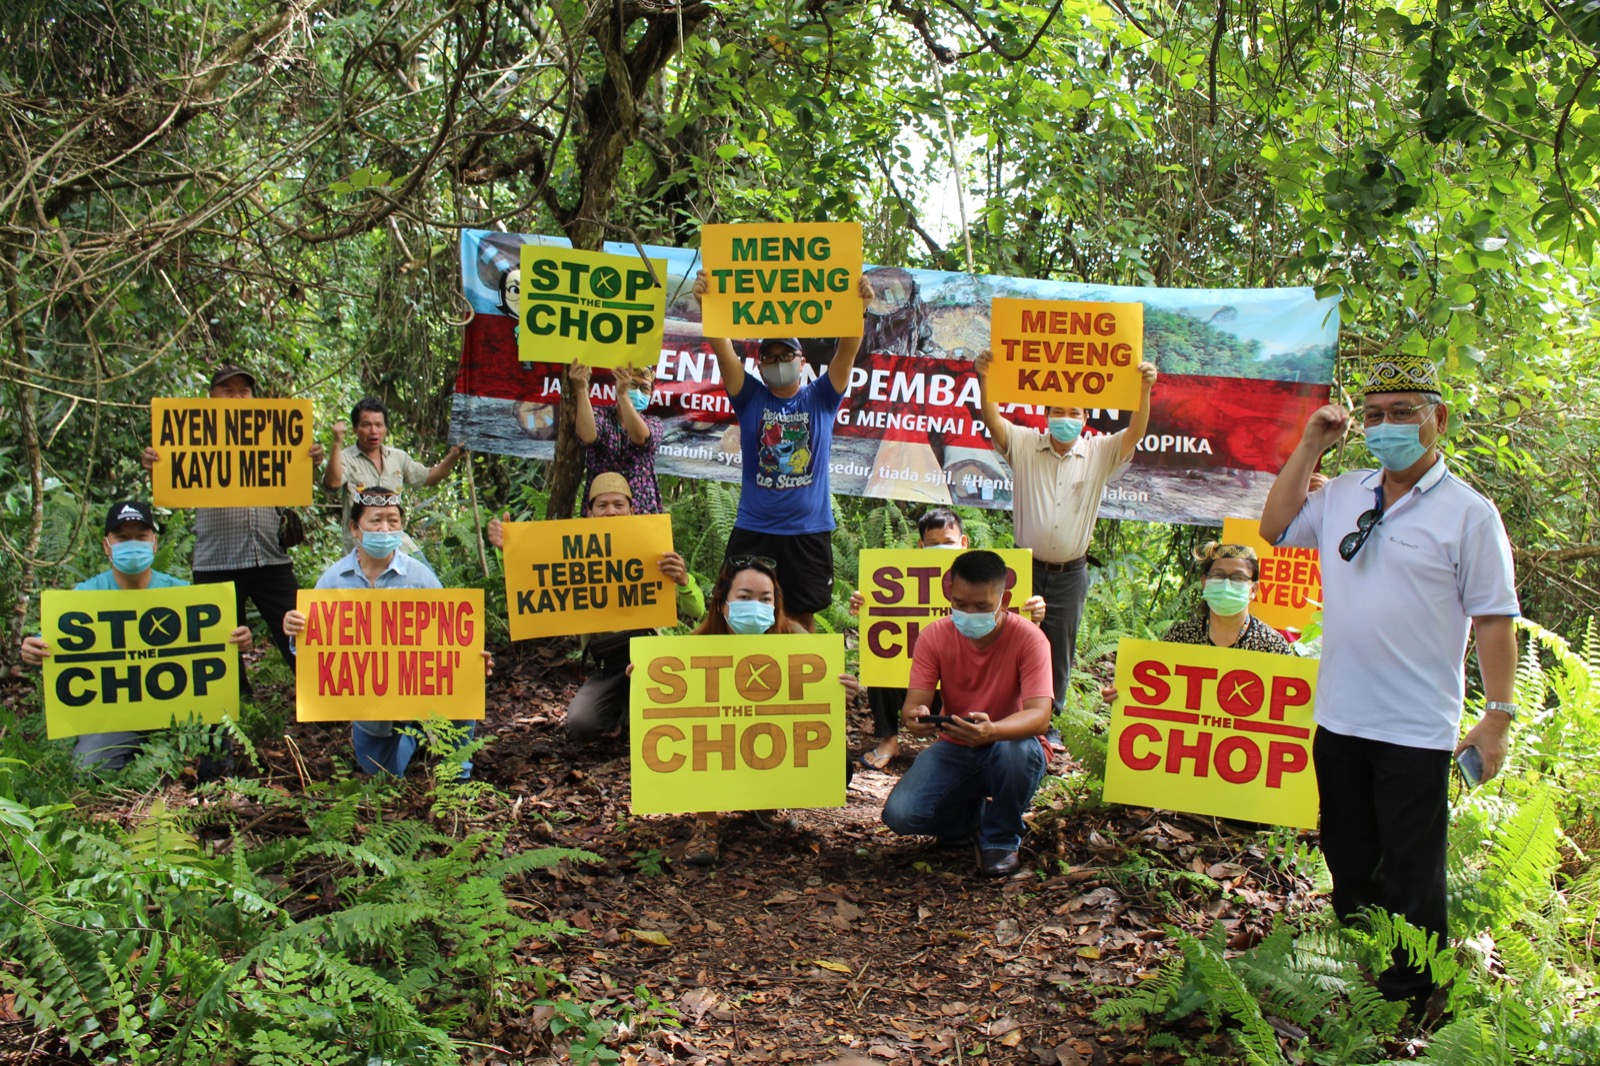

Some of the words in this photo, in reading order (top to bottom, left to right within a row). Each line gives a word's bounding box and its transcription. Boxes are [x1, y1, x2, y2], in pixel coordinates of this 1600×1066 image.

[732, 237, 831, 262] MENG
[531, 259, 655, 301] STOP
[712, 268, 849, 294] TEVENG
[580, 297, 601, 308] THE
[732, 300, 832, 326] KAYO'
[526, 304, 654, 345] CHOP
[1021, 310, 1116, 337] MENG
[1001, 339, 1132, 367] TEVENG
[1018, 369, 1114, 395] KAYO'
[160, 408, 218, 447] AYEN
[225, 408, 304, 447] NEP'NG
[679, 392, 735, 414] CERIT
[856, 410, 964, 436] MENGENAI
[172, 451, 232, 489] KAYU
[240, 450, 292, 488] MEH'
[879, 466, 919, 482] tiada
[924, 470, 956, 488] sijil.
[562, 533, 612, 560] MAI
[533, 559, 645, 588] TEBENG
[517, 584, 609, 615] KAYEU
[618, 581, 663, 608] ME'
[56, 603, 222, 652] STOP
[305, 601, 373, 647] AYEN
[380, 601, 474, 647] NEP'NG
[128, 648, 157, 660] THE
[54, 657, 227, 706] CHOP
[318, 651, 389, 697] KAYU
[398, 651, 461, 696] MEH'
[647, 653, 828, 705] STOP
[1129, 659, 1312, 722] STOP
[722, 705, 753, 718] THE
[1201, 714, 1232, 729] THE
[641, 721, 832, 774] CHOP
[1118, 722, 1309, 789] CHOP
